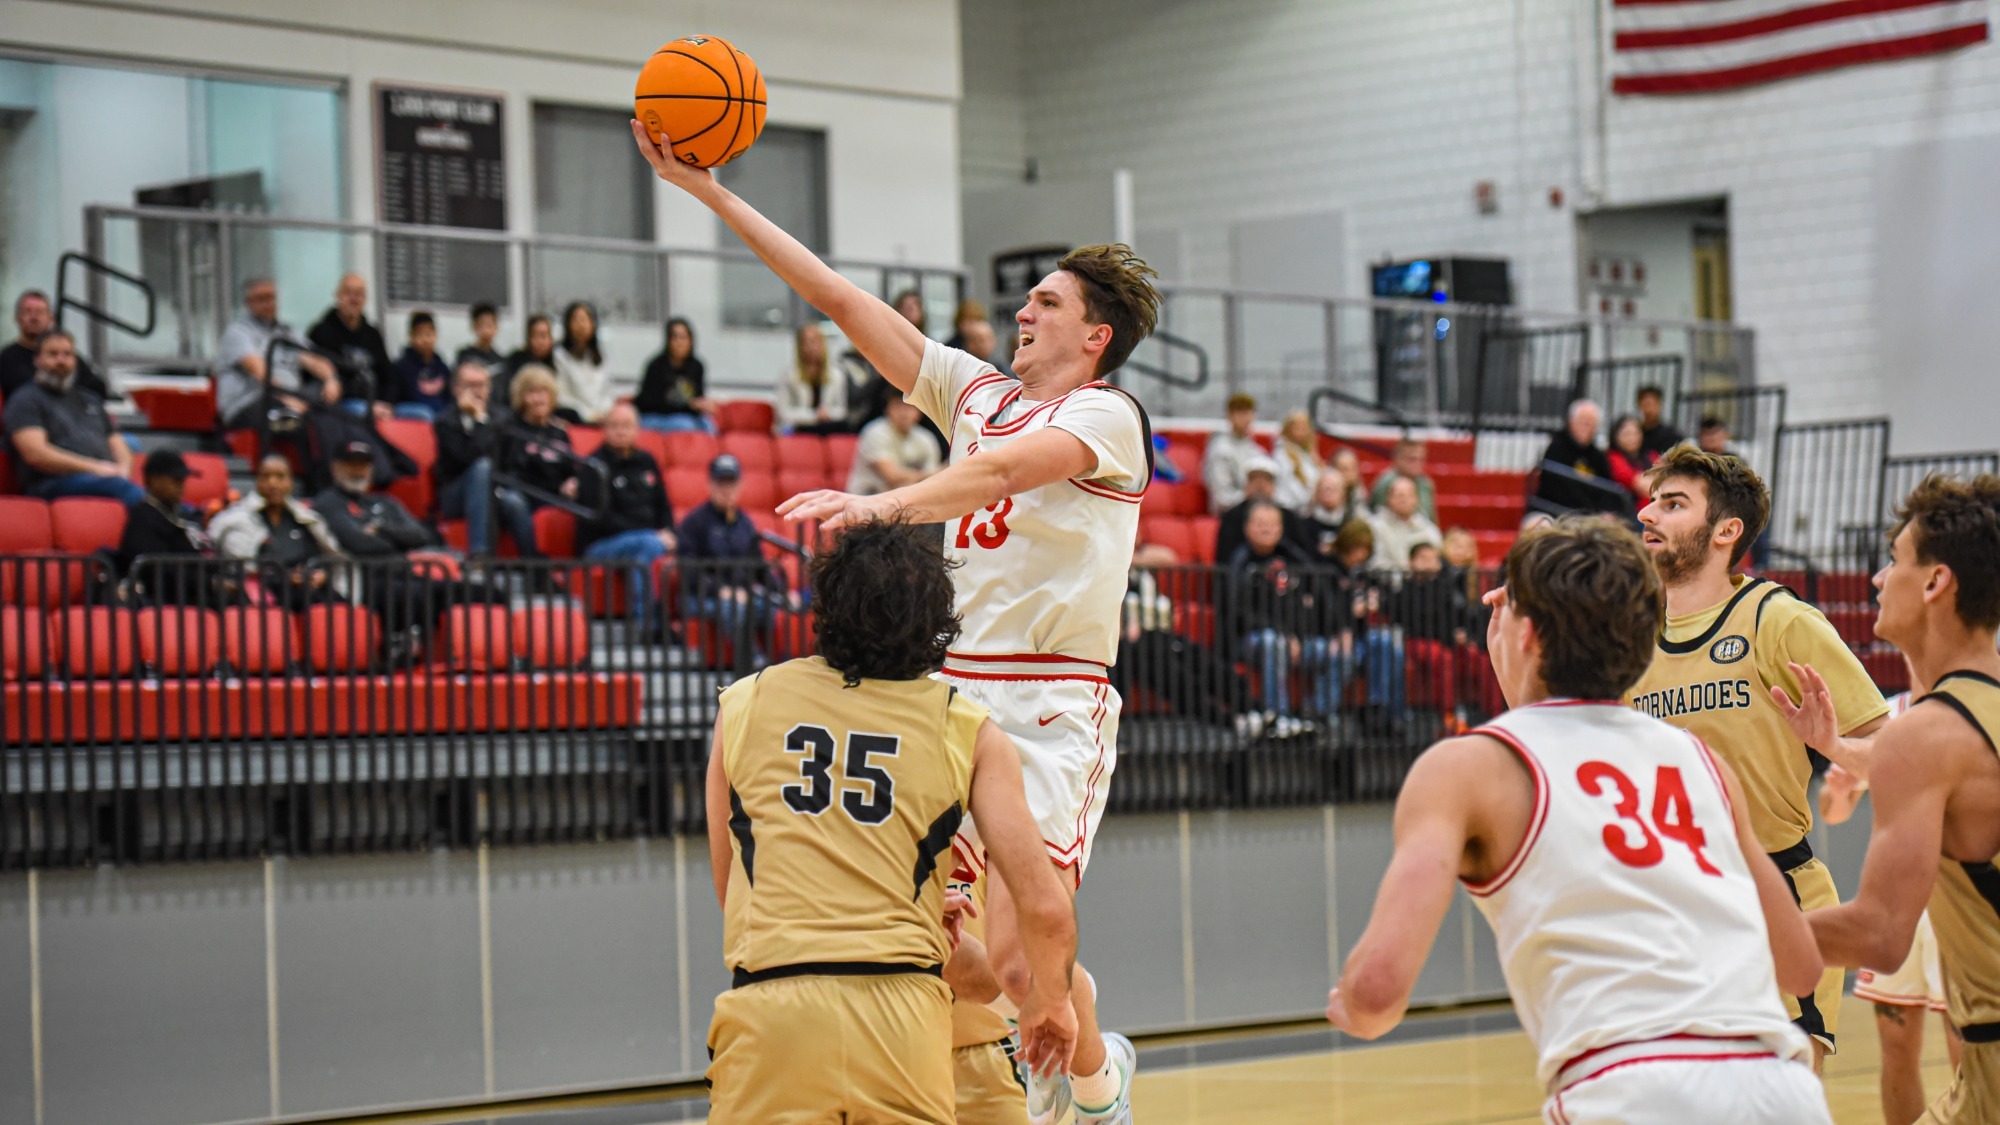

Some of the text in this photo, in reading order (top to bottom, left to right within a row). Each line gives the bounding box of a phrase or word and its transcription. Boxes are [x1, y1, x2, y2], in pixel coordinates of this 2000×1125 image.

[955, 496, 1014, 550] 13
[1717, 642, 1740, 657] PAC
[1632, 679, 1751, 719] TORNADOES
[780, 722, 902, 827] 35
[1576, 760, 1724, 878] 34
